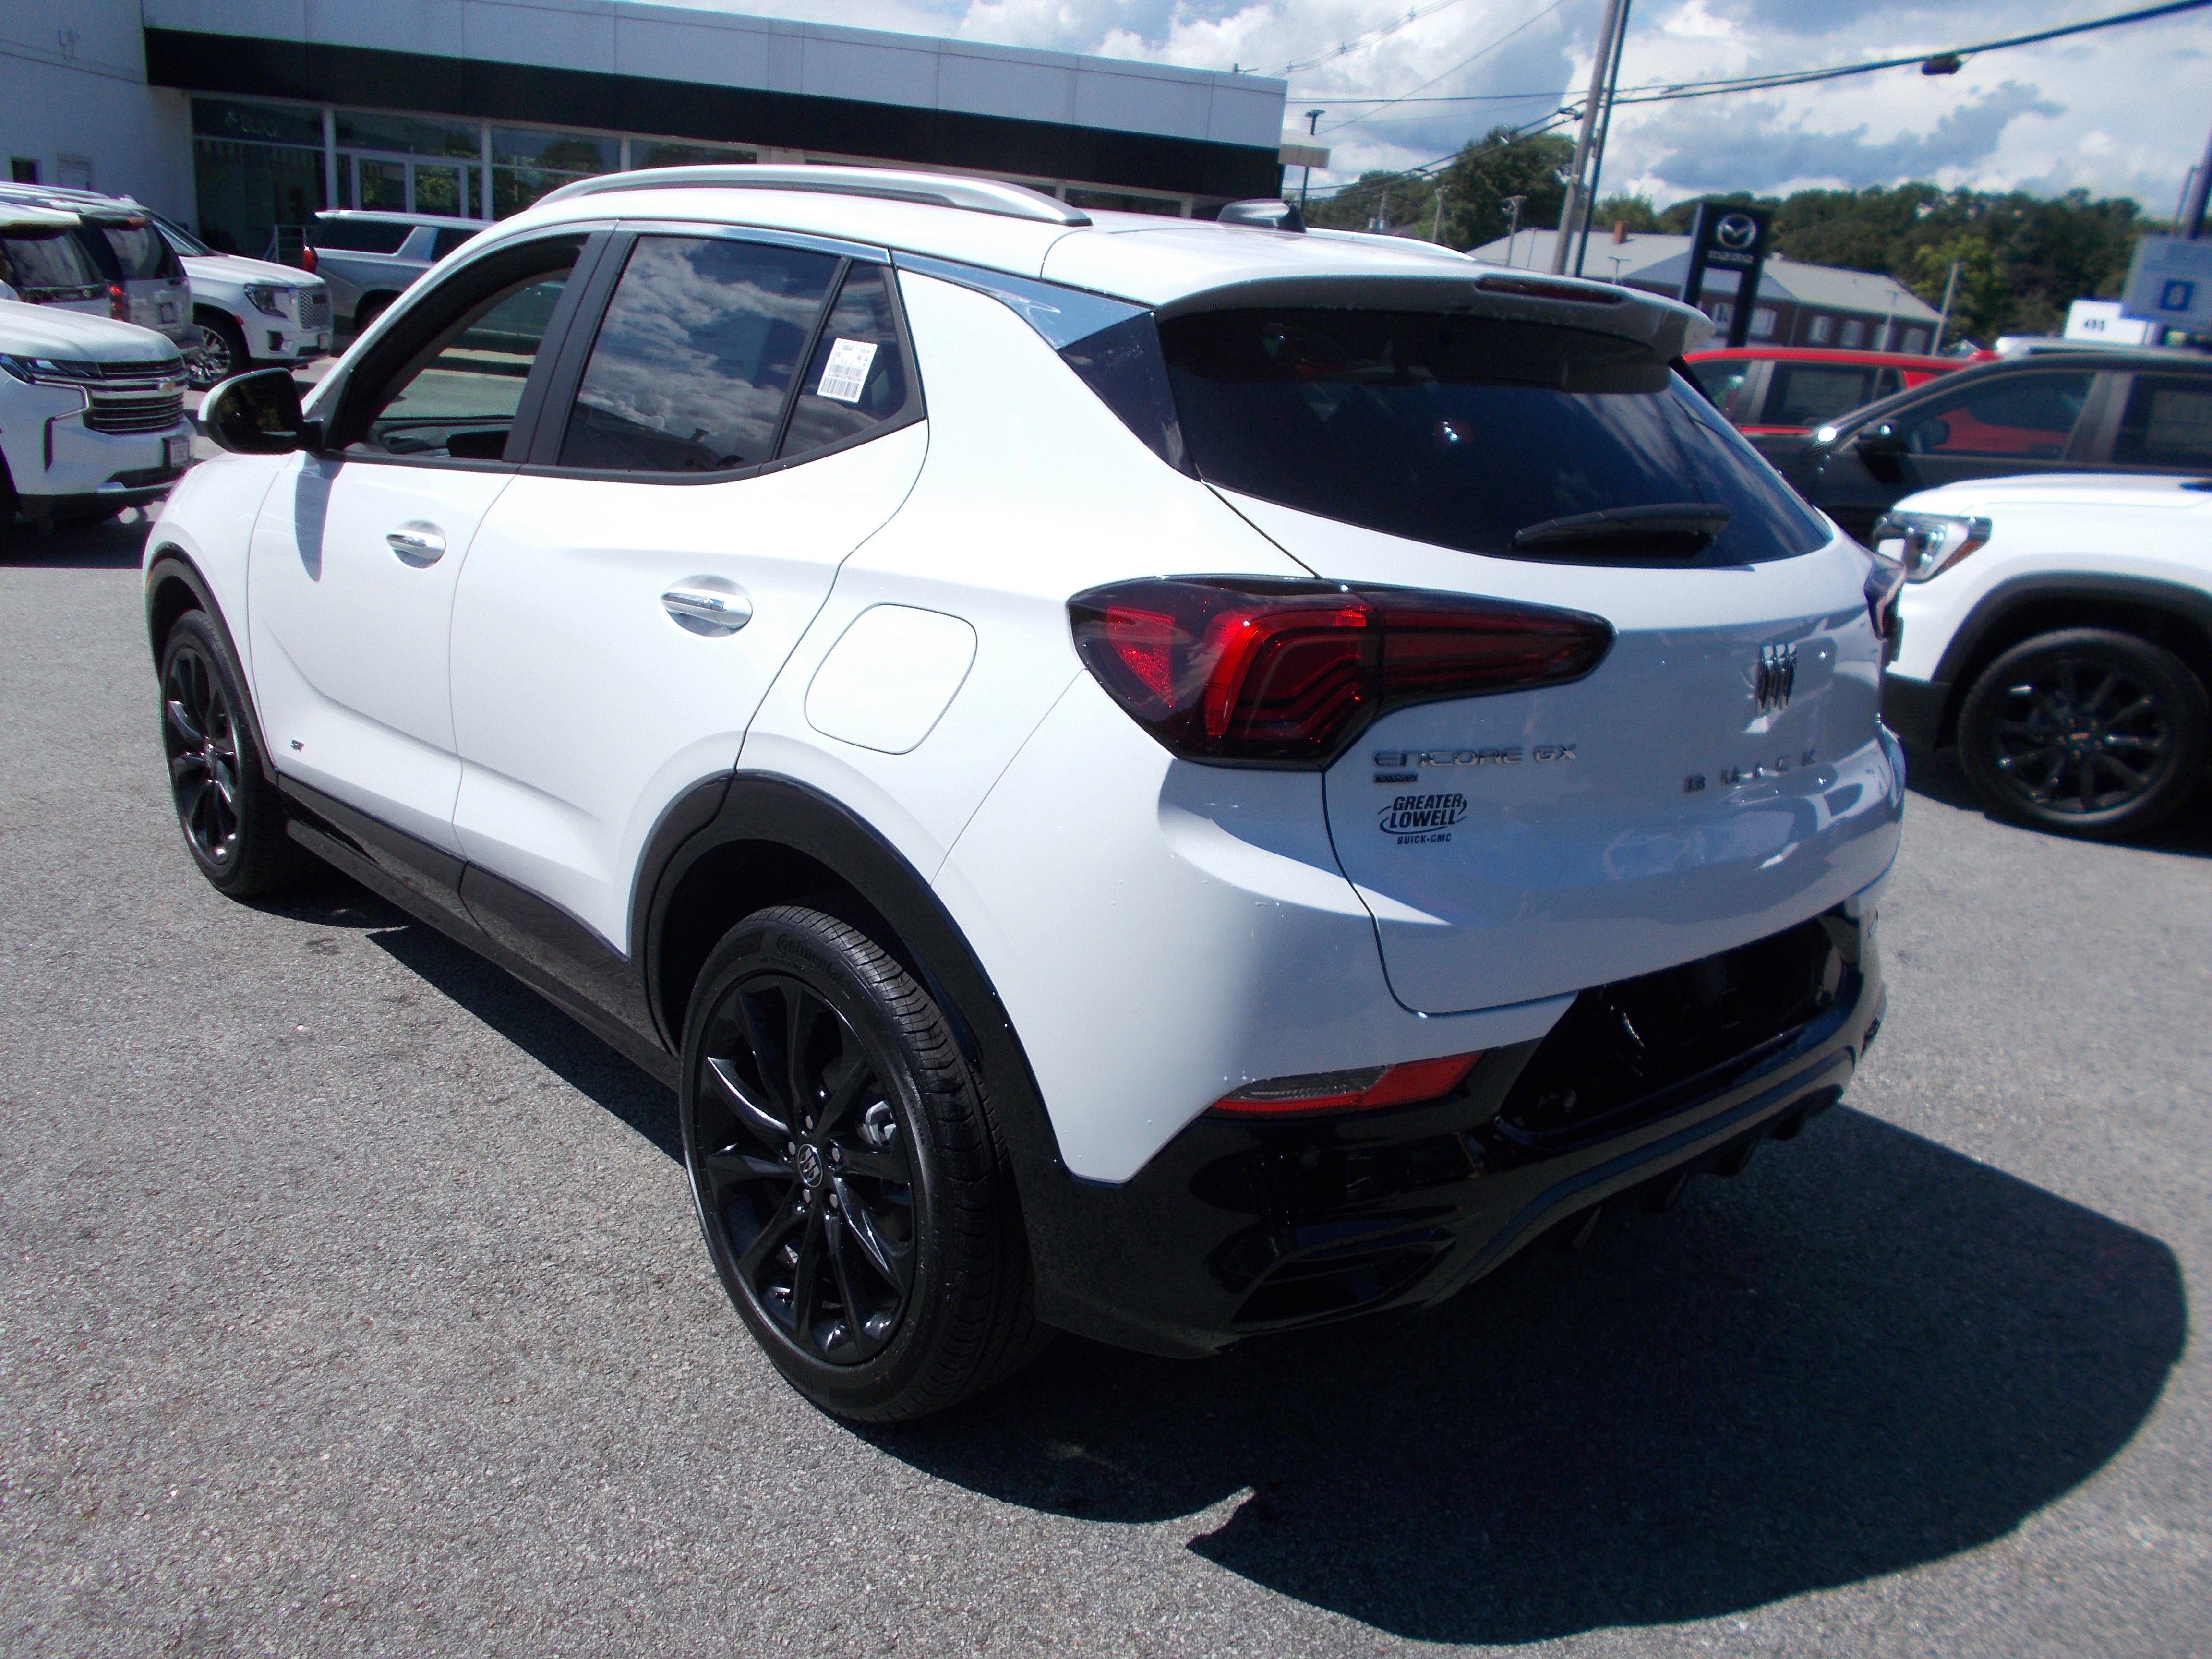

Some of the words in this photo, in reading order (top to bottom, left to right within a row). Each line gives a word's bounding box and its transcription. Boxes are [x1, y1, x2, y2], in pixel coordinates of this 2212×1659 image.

[1374, 748, 1524, 767] ENCORE
[1534, 742, 1576, 762] GX
[1683, 748, 1817, 793] BUICK
[1393, 793, 1464, 811] GREATER
[1389, 808, 1456, 829] LOWELL
